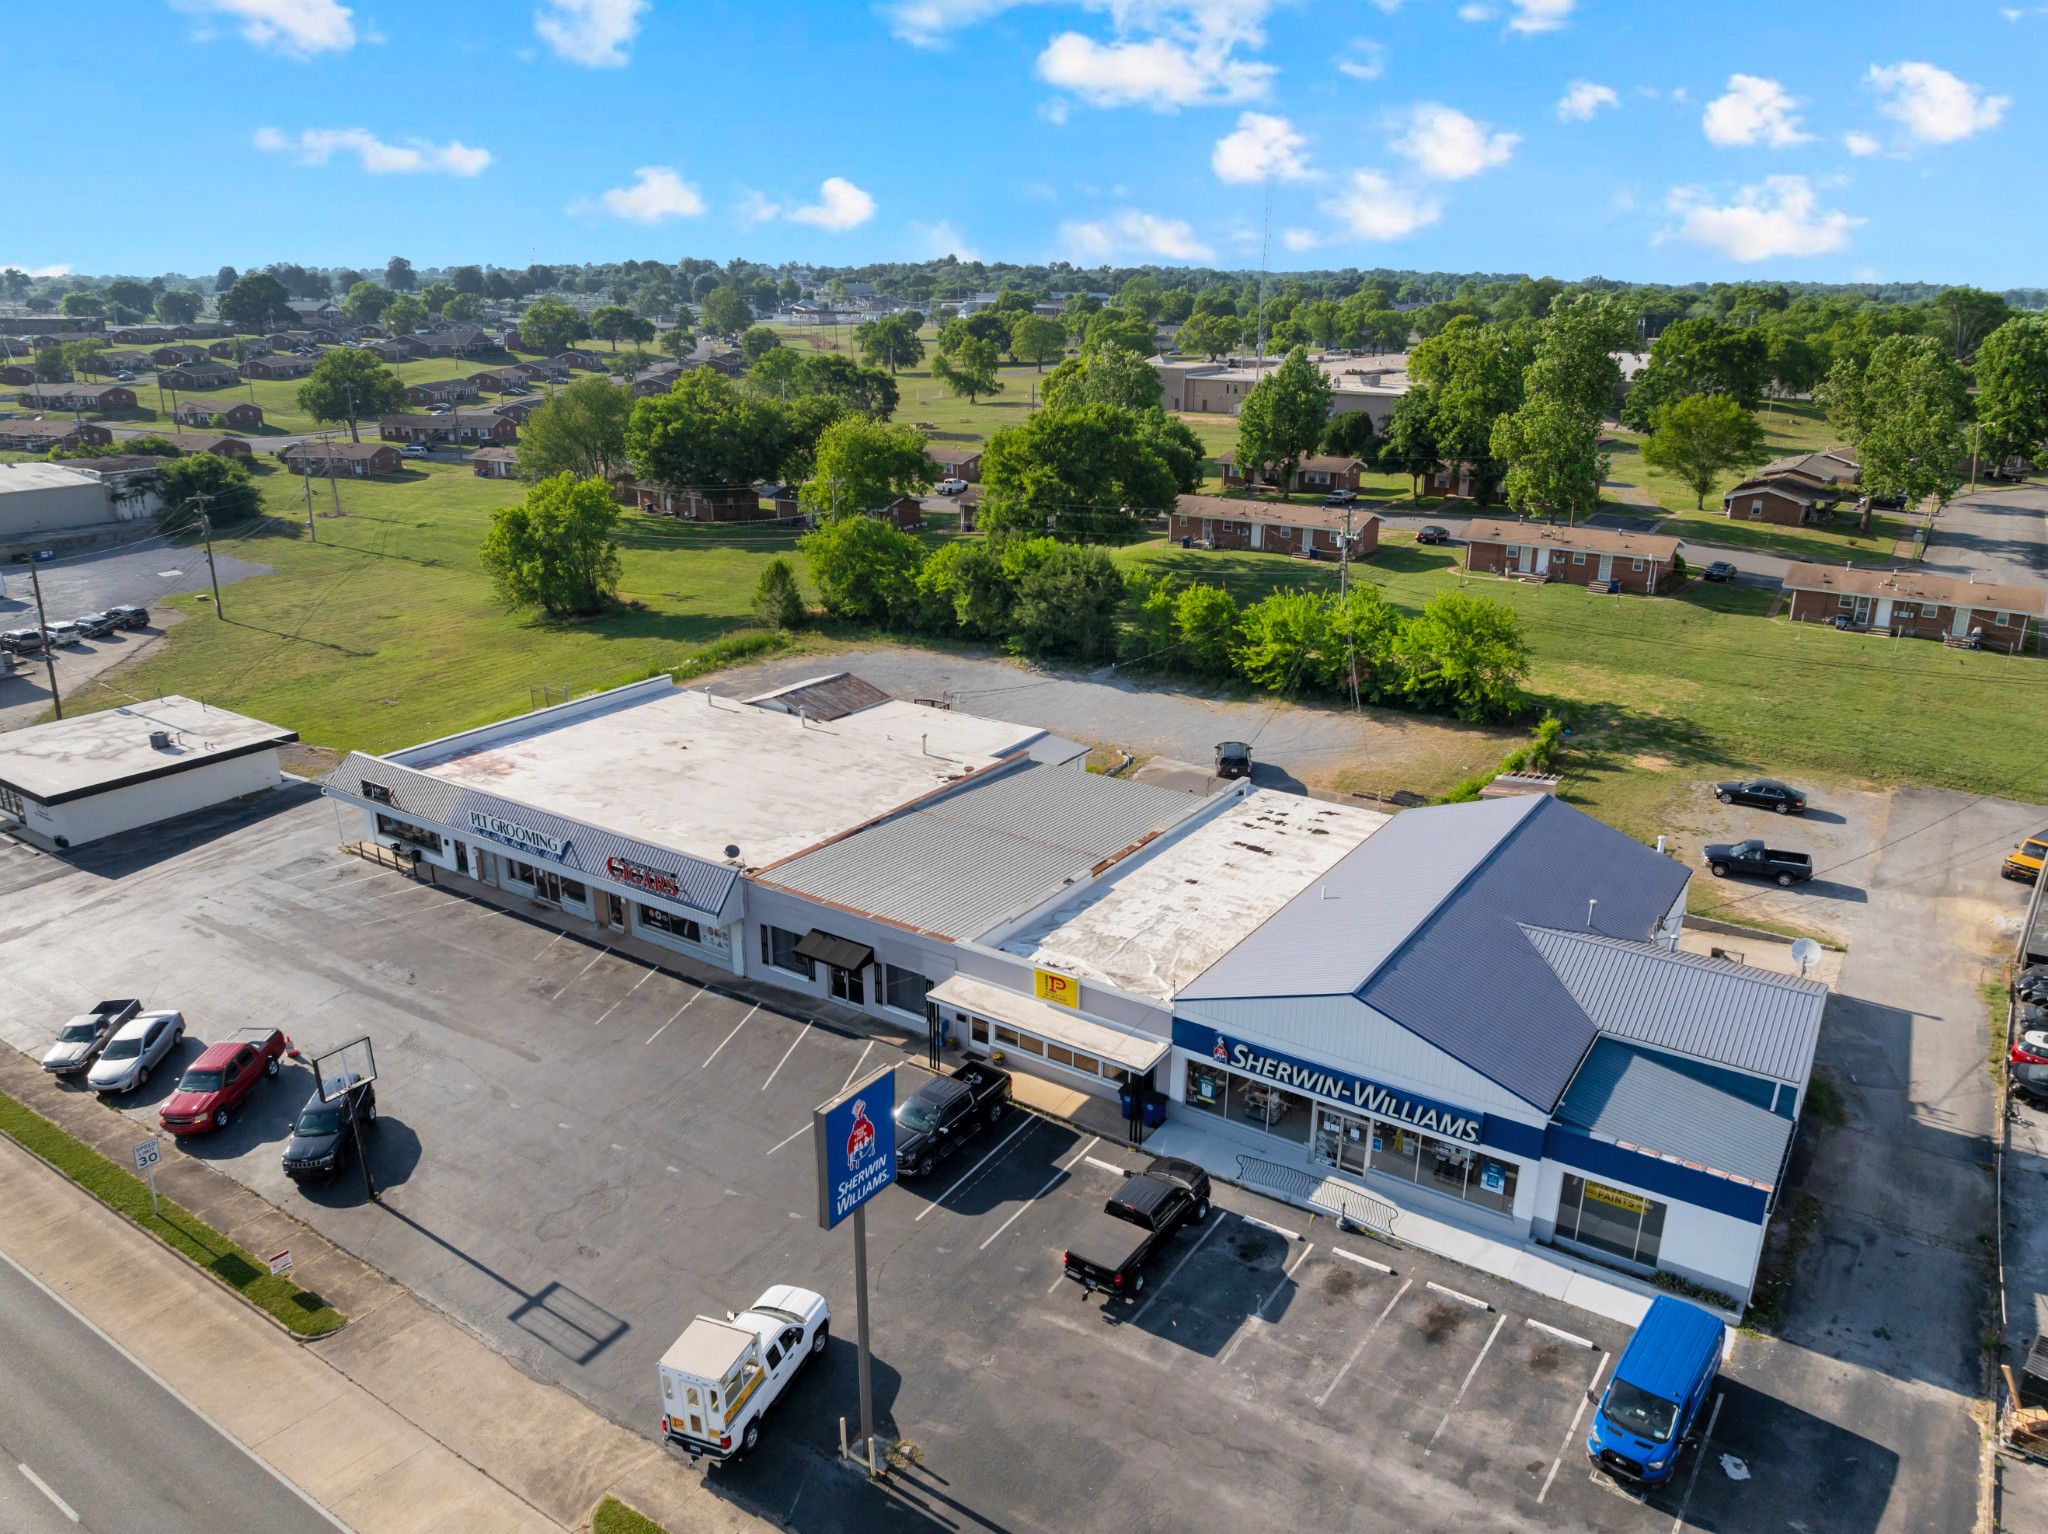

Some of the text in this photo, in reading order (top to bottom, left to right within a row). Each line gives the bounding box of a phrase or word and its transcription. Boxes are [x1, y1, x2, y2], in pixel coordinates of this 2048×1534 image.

[471, 811, 558, 851] PET GROOMING
[607, 856, 677, 897] CIGARS
[1230, 1043, 1479, 1142] SHERWIN-WILLIAMS
[135, 1141, 156, 1152] SPEED
[138, 1147, 155, 1156] LIMIT
[138, 1152, 158, 1166] 30
[837, 1153, 887, 1200] SHERWIN
[837, 1169, 888, 1216] WILLIAMS
[1597, 1191, 1635, 1208] PAINTS
